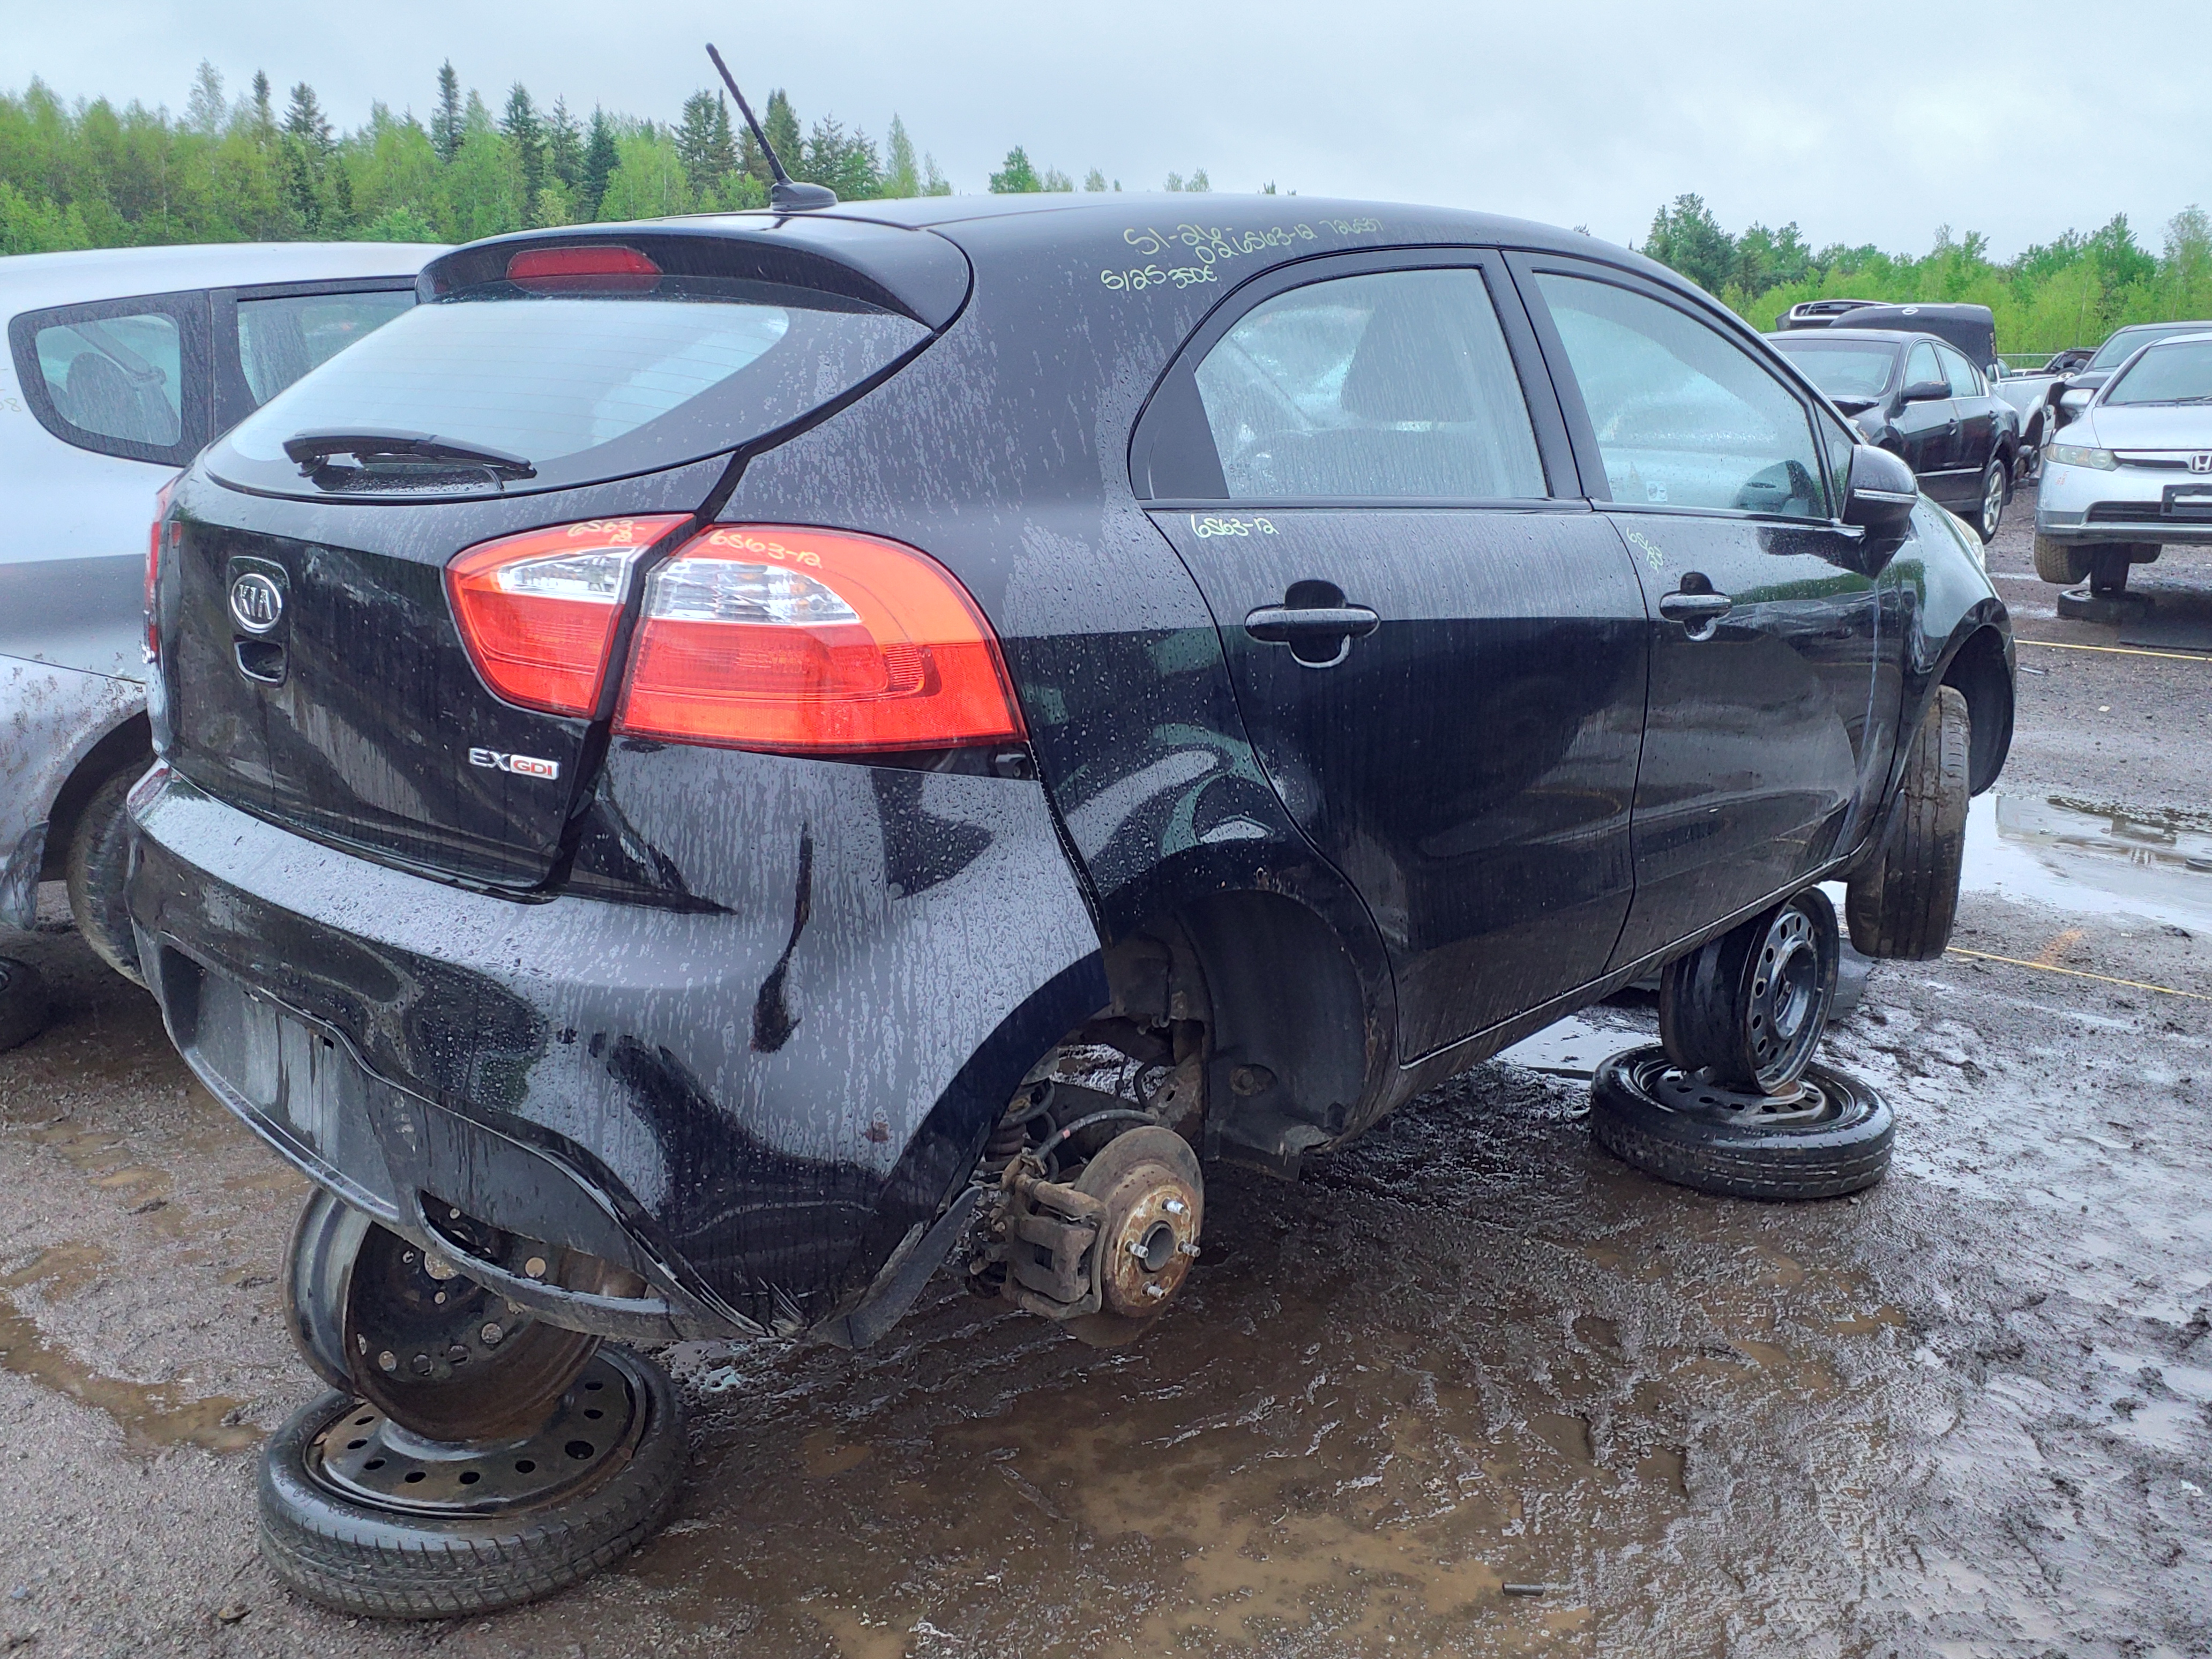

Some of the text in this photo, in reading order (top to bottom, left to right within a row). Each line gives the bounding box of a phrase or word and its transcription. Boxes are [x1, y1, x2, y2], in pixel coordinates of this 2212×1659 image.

[239, 584, 273, 620] KIA
[469, 748, 553, 776] EX GDI
